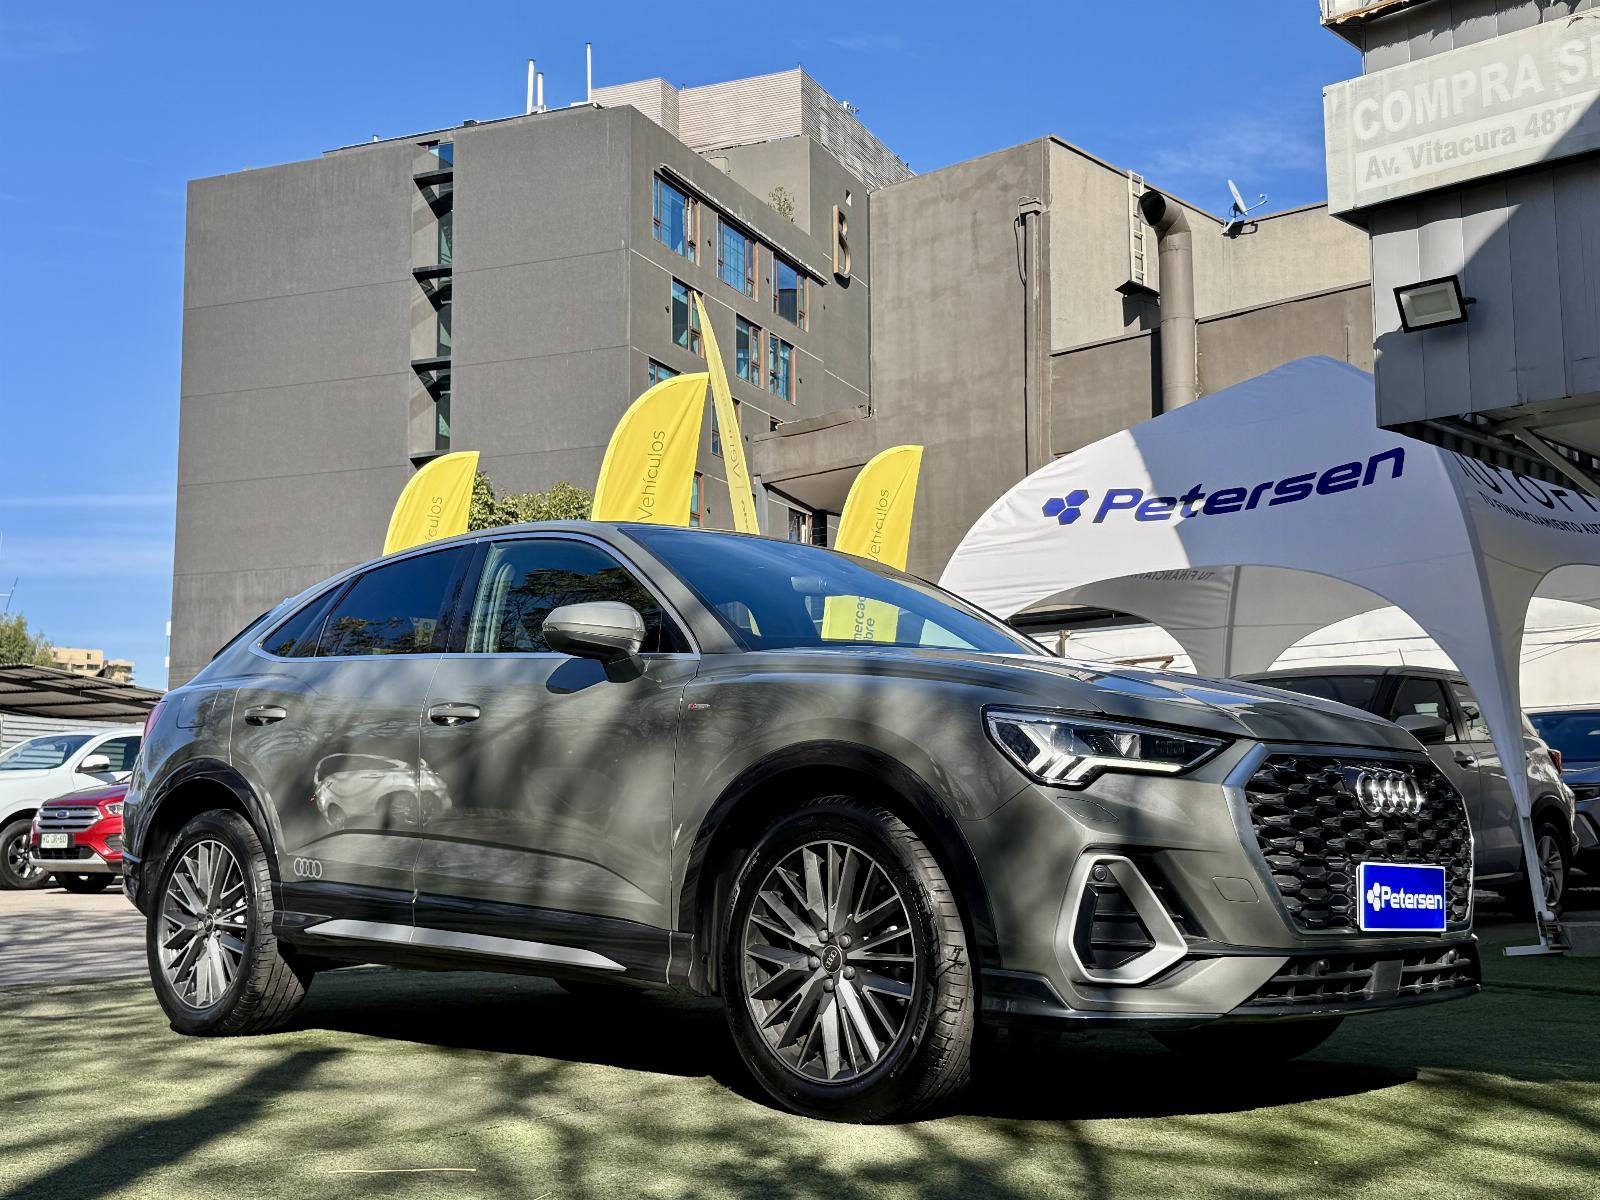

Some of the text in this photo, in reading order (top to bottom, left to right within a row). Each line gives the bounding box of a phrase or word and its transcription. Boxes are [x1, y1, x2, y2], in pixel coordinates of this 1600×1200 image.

[1352, 54, 1544, 141] COMPRA
[1365, 156, 1400, 183] Av.
[1405, 126, 1516, 169] Vitacura
[637, 430, 666, 521] Vehículos
[1092, 446, 1405, 524] Petersen
[1381, 886, 1443, 910] Petersen
